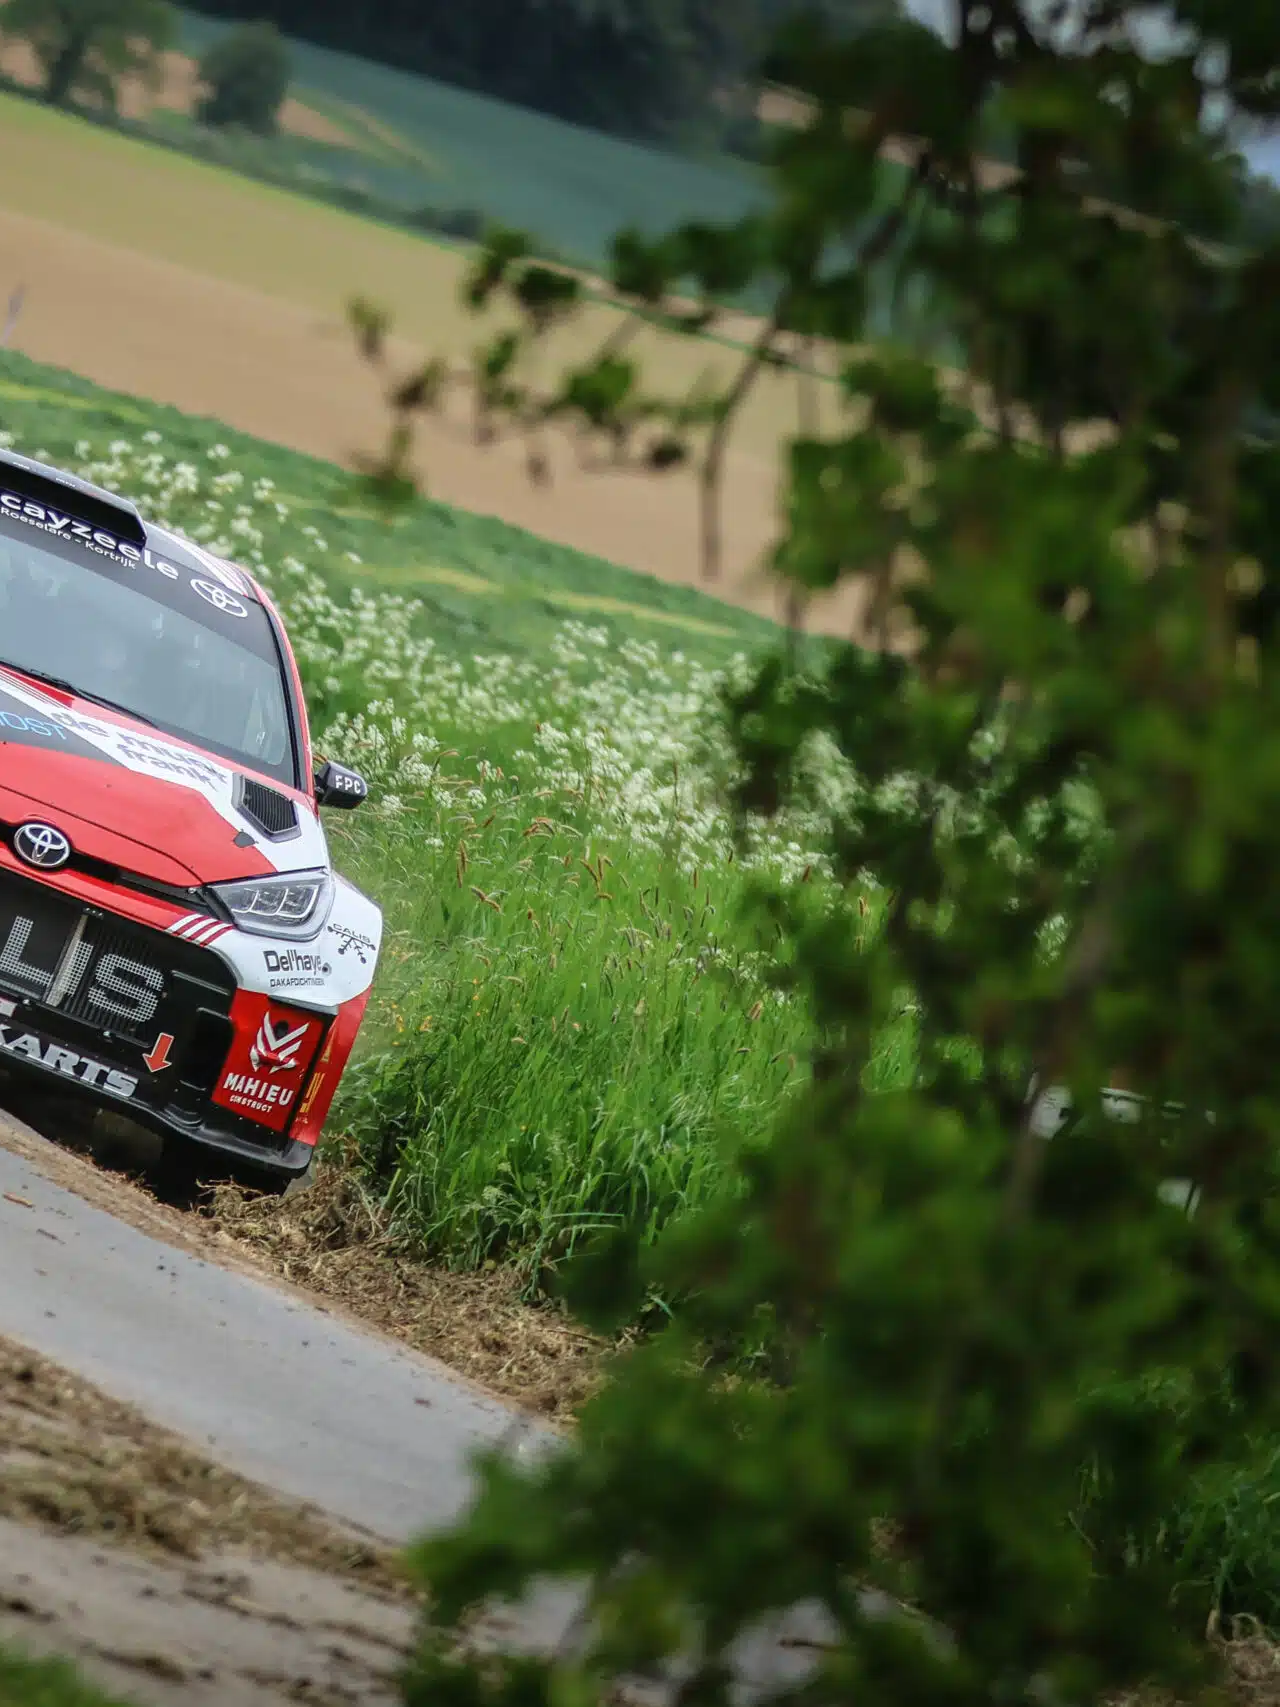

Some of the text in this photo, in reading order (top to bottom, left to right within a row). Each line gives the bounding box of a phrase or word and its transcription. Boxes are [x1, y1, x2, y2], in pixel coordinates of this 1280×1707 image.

[0, 506, 71, 541] Roeselare
[85, 540, 136, 570] Kortrijk
[51, 712, 111, 738] de
[117, 743, 219, 793] frank
[335, 774, 361, 794] FPC
[263, 949, 322, 976] Del'haye
[223, 1072, 295, 1106] MAHIEU
